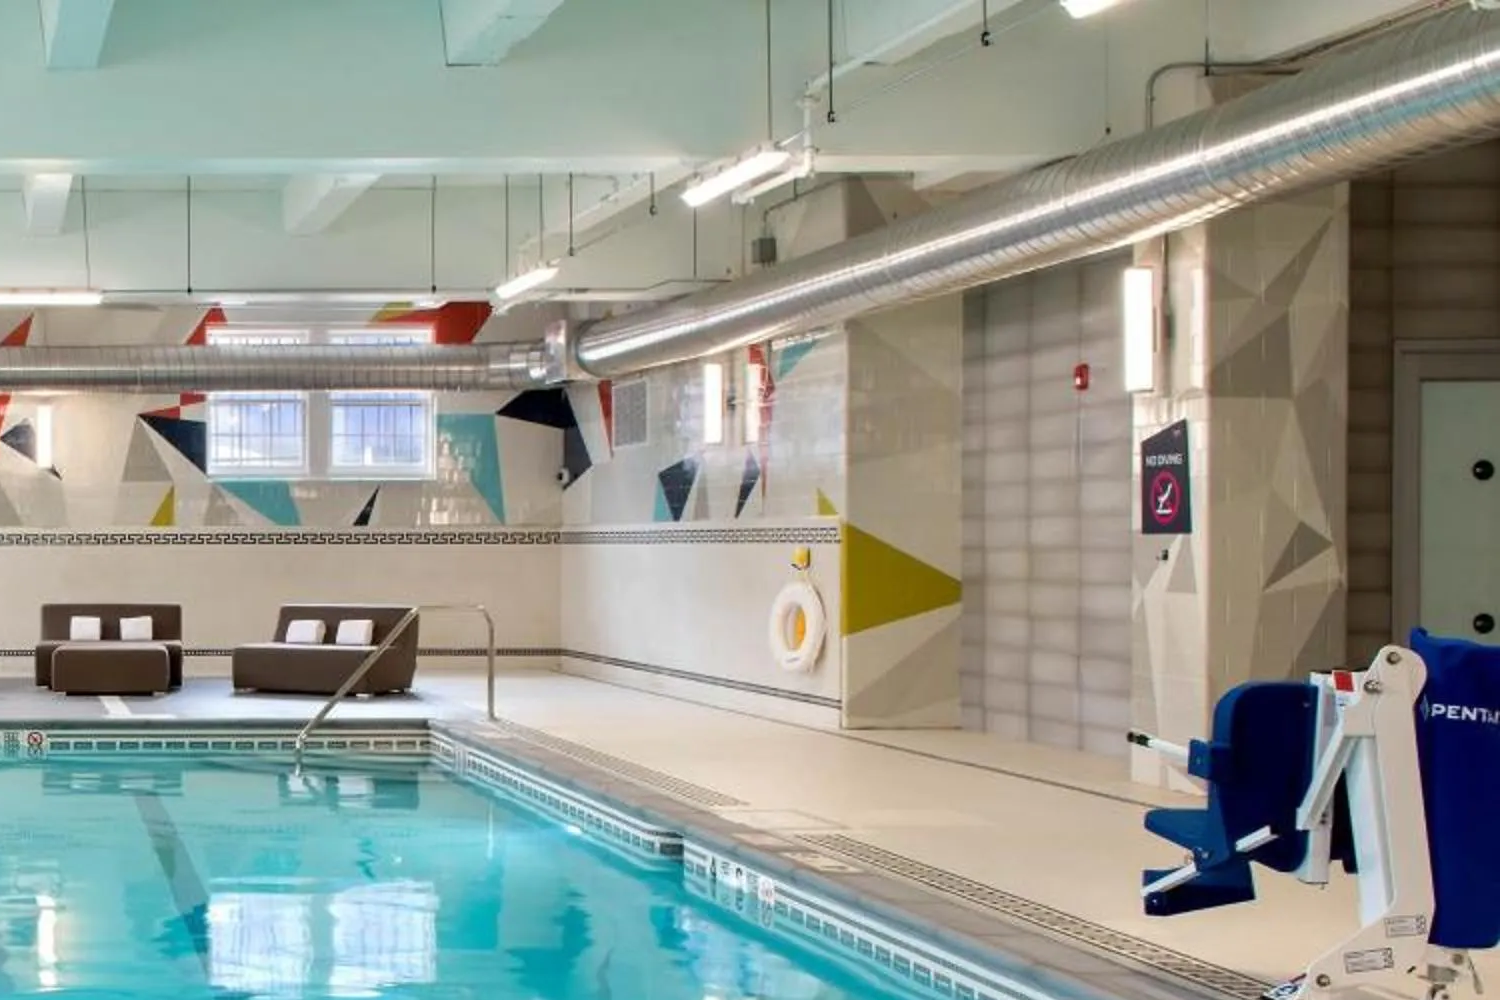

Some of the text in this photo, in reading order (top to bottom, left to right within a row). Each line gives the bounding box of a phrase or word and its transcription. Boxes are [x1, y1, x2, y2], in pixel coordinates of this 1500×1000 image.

[1146, 453, 1182, 466] NO DIVING
[1432, 703, 1500, 724] PENTAI
